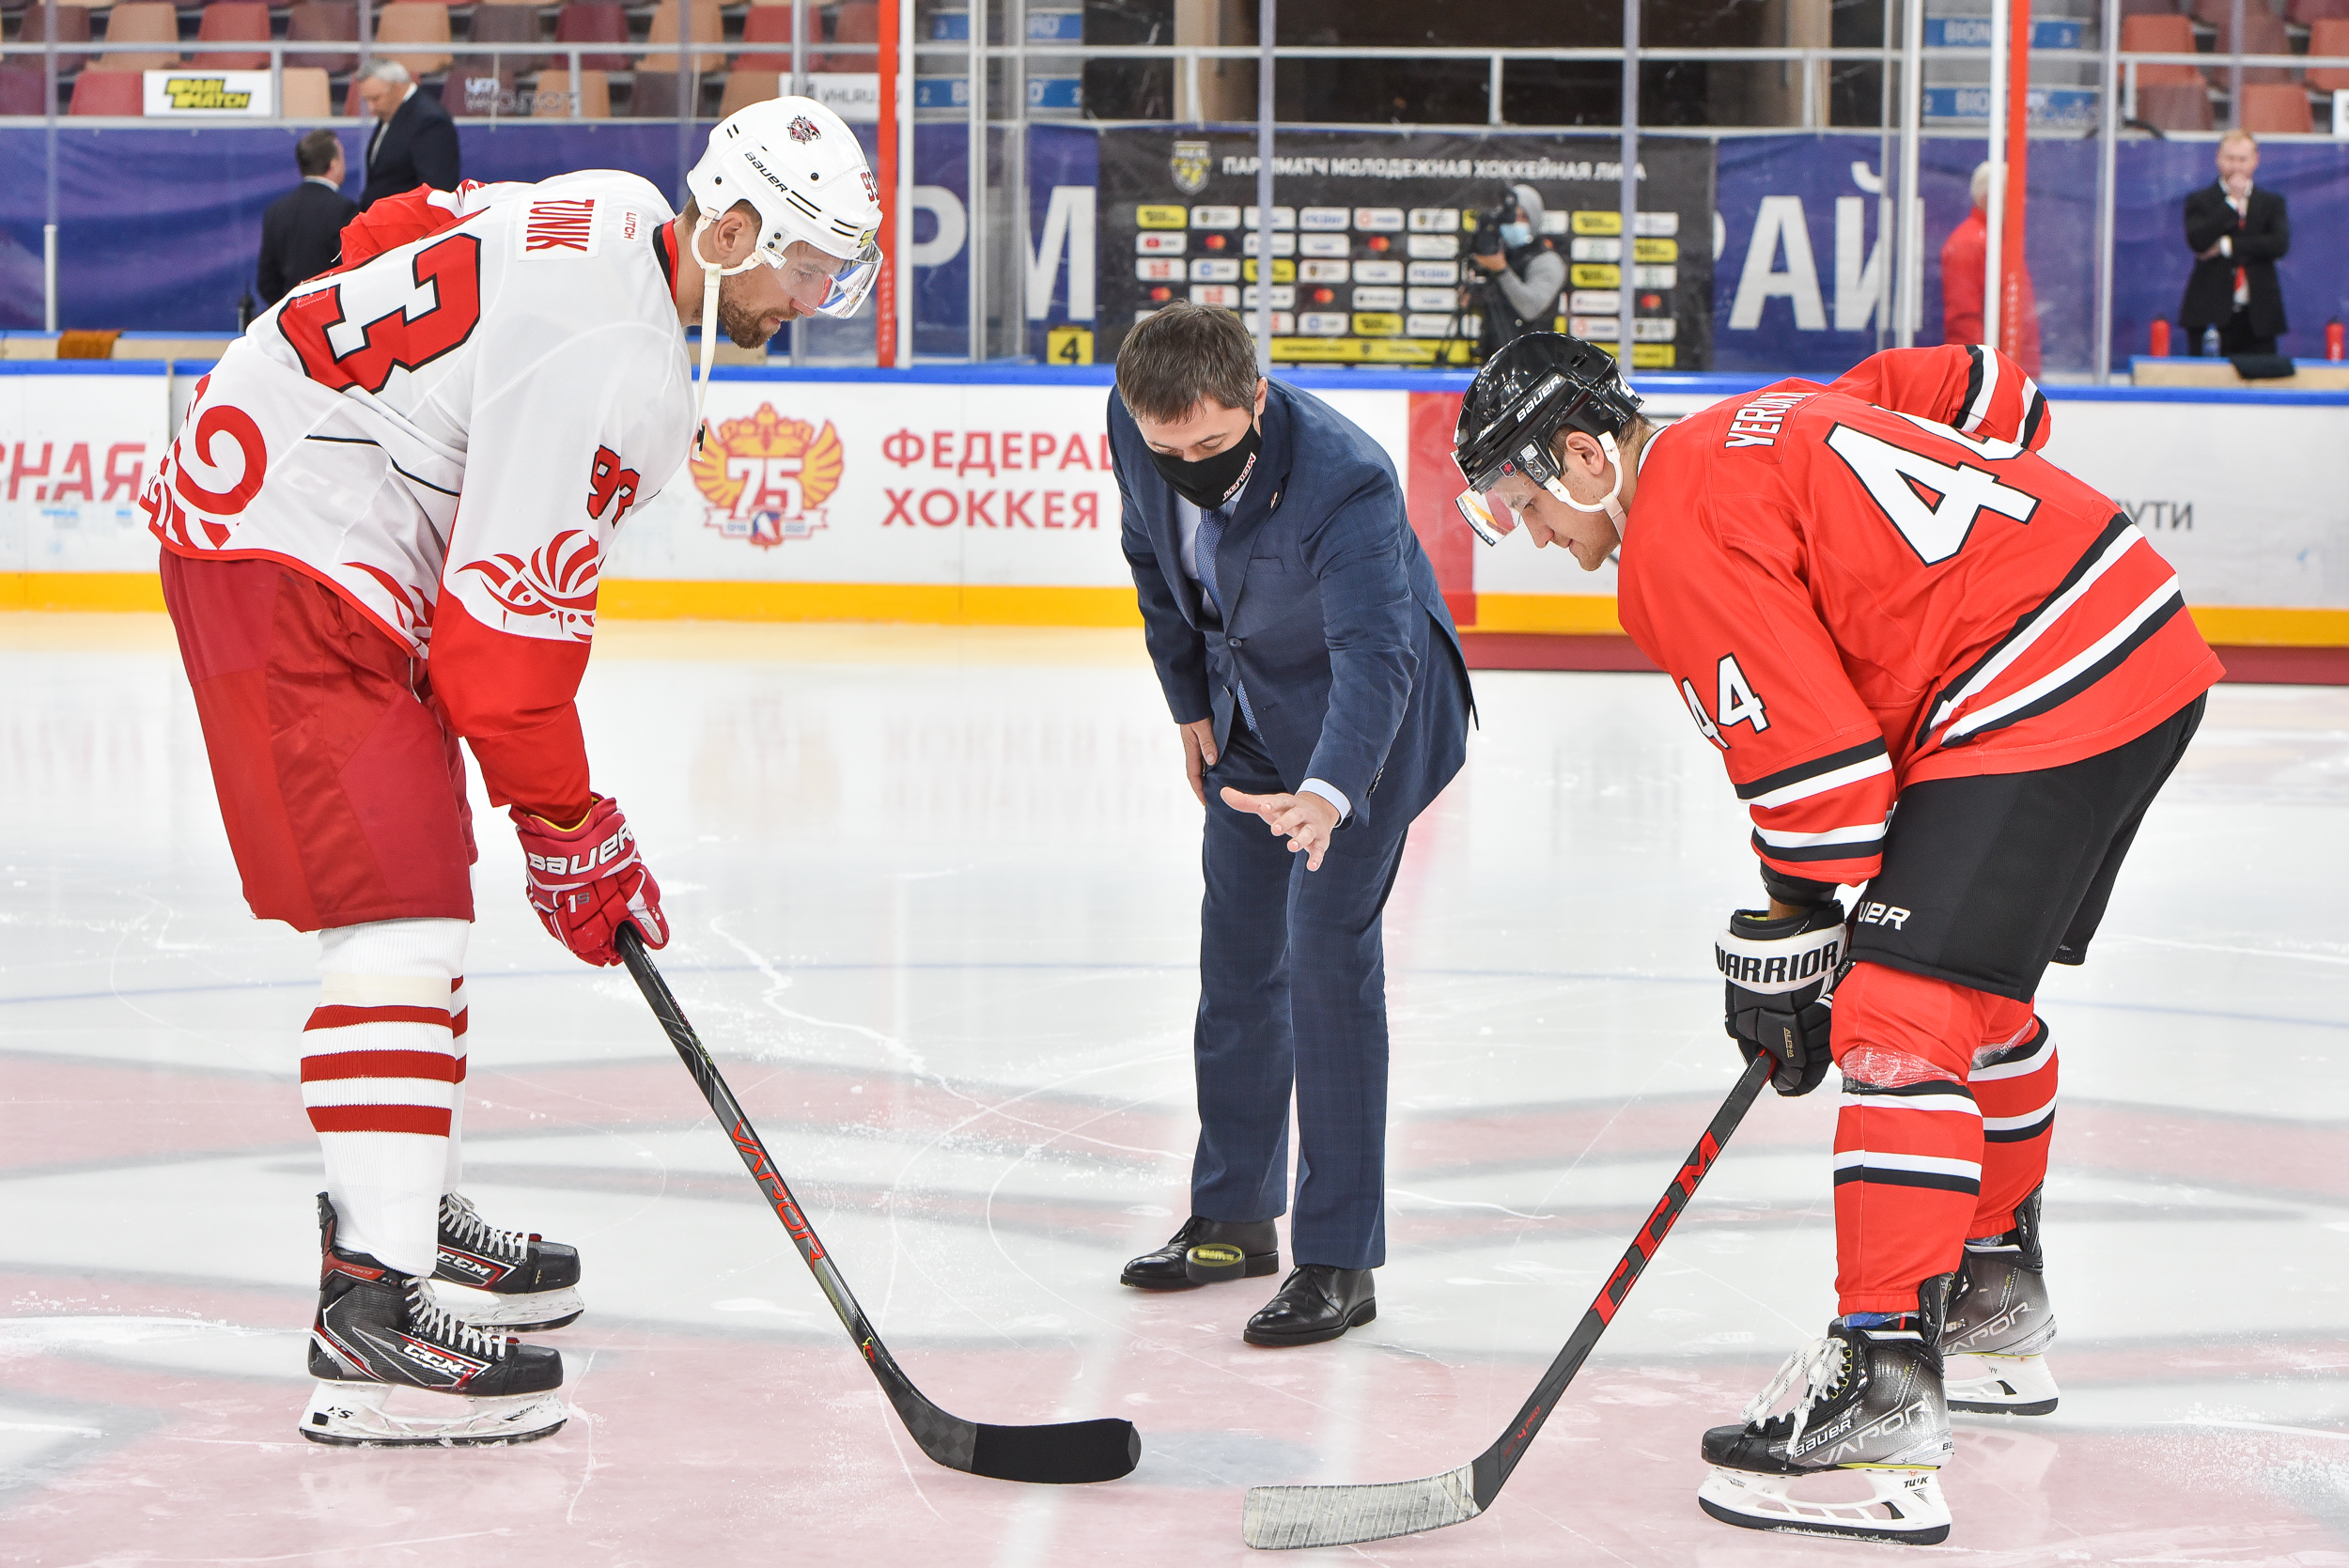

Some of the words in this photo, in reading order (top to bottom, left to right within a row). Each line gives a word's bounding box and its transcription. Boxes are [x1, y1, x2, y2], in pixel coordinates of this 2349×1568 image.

[744, 151, 787, 193] BAUER
[1222, 156, 1329, 177] ПАРМАТЧ
[1331, 157, 1472, 179] МОЛОДЕЖНАЯ
[1473, 157, 1593, 179] ХОККЕЙНАЯ
[1594, 162, 1647, 181] ЛИА
[526, 199, 595, 252] TUNIK
[623, 211, 637, 241] LUTCH
[1713, 162, 1924, 331] АЙ
[276, 214, 485, 396] 3
[1059, 336, 1080, 364] 4
[1517, 373, 1563, 423] BAUER
[0, 441, 147, 503] НАЯ
[726, 457, 803, 520] 75
[881, 487, 1098, 529] ХОККЕЯ
[2112, 500, 2194, 531] УТИ
[1681, 651, 1771, 750] 44
[527, 819, 633, 876] BAUER
[1784, 1028, 1795, 1058] ALPHA
[732, 1117, 825, 1272] VAPOR
[1590, 1130, 1719, 1327] CCM
[437, 1250, 491, 1276] CCM
[403, 1343, 467, 1374] CCM
[1794, 1419, 1852, 1458] BAUER
[1904, 1476, 1929, 1488] TUK
